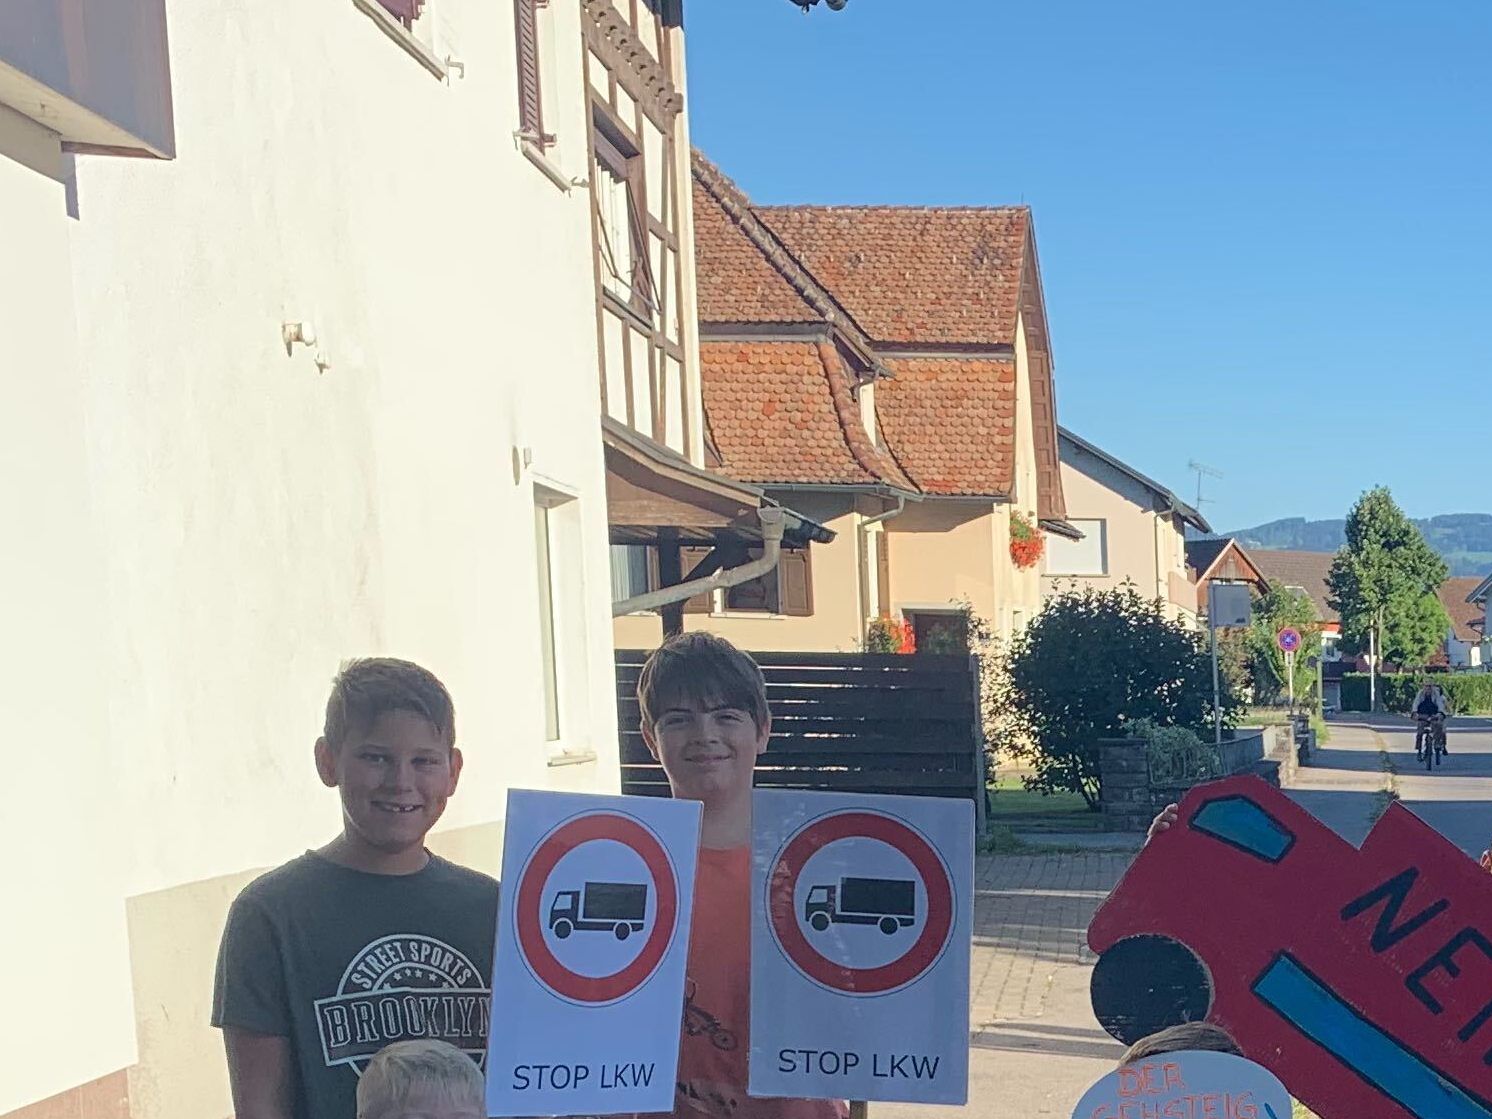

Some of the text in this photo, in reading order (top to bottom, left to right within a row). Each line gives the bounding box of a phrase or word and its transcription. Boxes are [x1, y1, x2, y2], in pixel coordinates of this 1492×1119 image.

[351, 941, 471, 989] STREET SPORTS
[512, 1063, 656, 1091] STOP LKW
[778, 1049, 941, 1080] STOP LKW
[1117, 1063, 1185, 1098] DER
